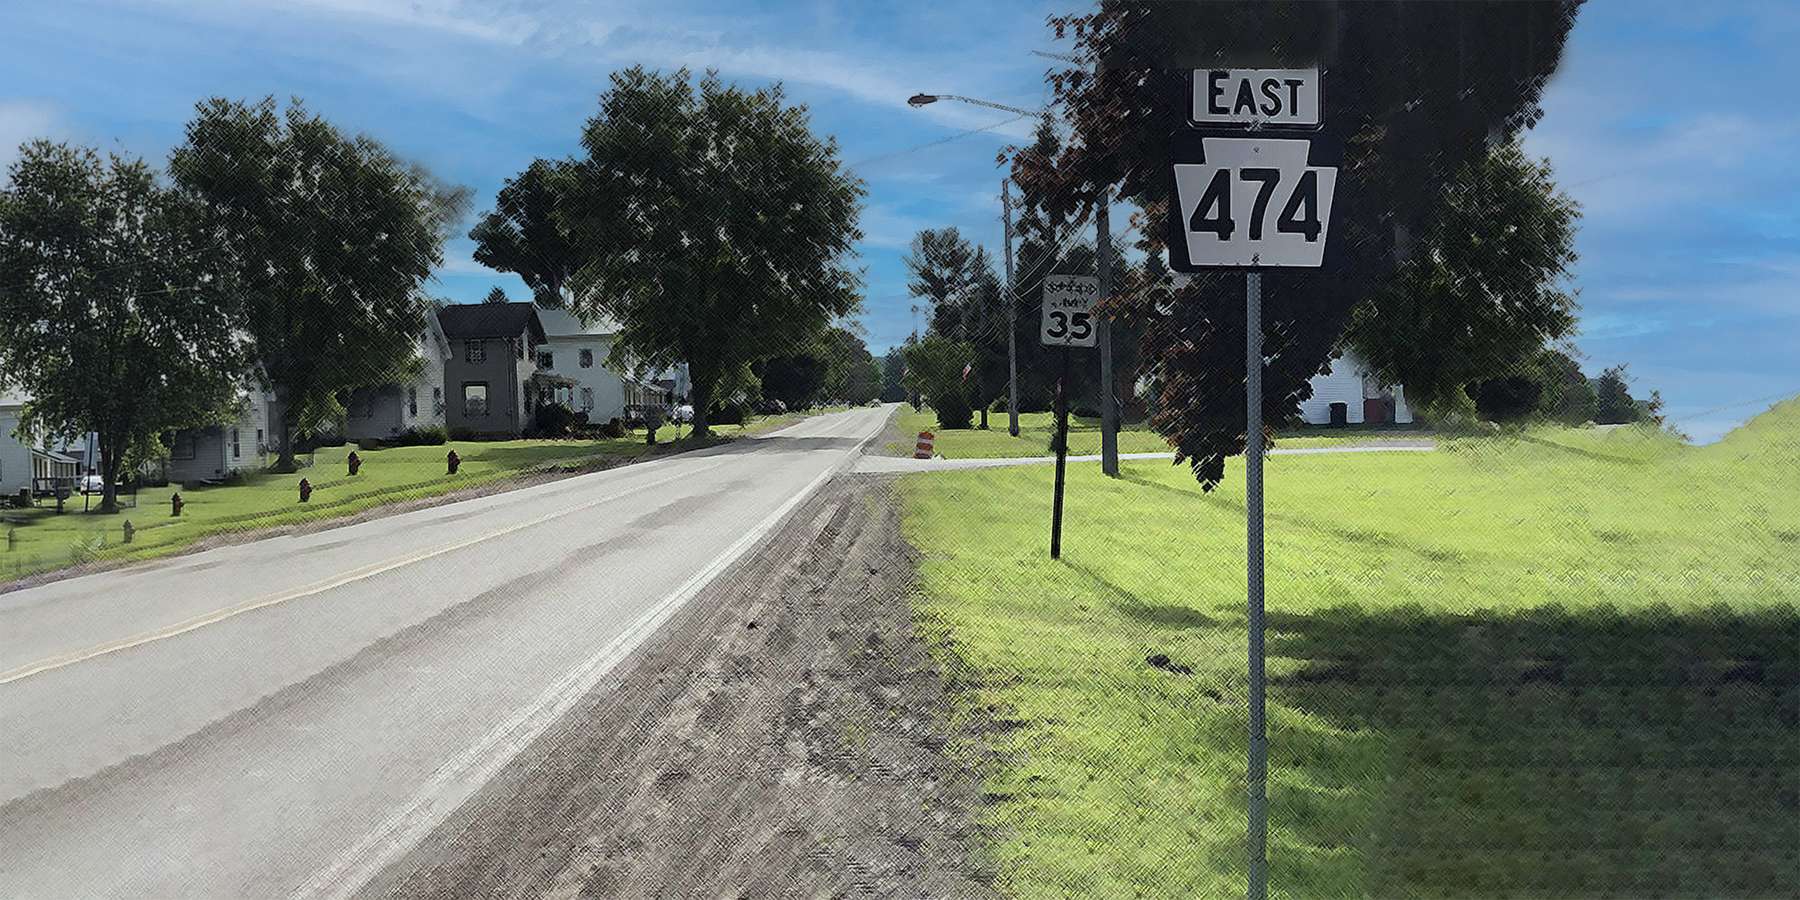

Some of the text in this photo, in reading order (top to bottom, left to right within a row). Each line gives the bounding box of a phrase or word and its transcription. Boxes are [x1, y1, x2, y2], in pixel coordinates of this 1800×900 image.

[1207, 71, 1304, 117] EAST
[1189, 168, 1322, 243] 474
[1047, 311, 1092, 340] 35
